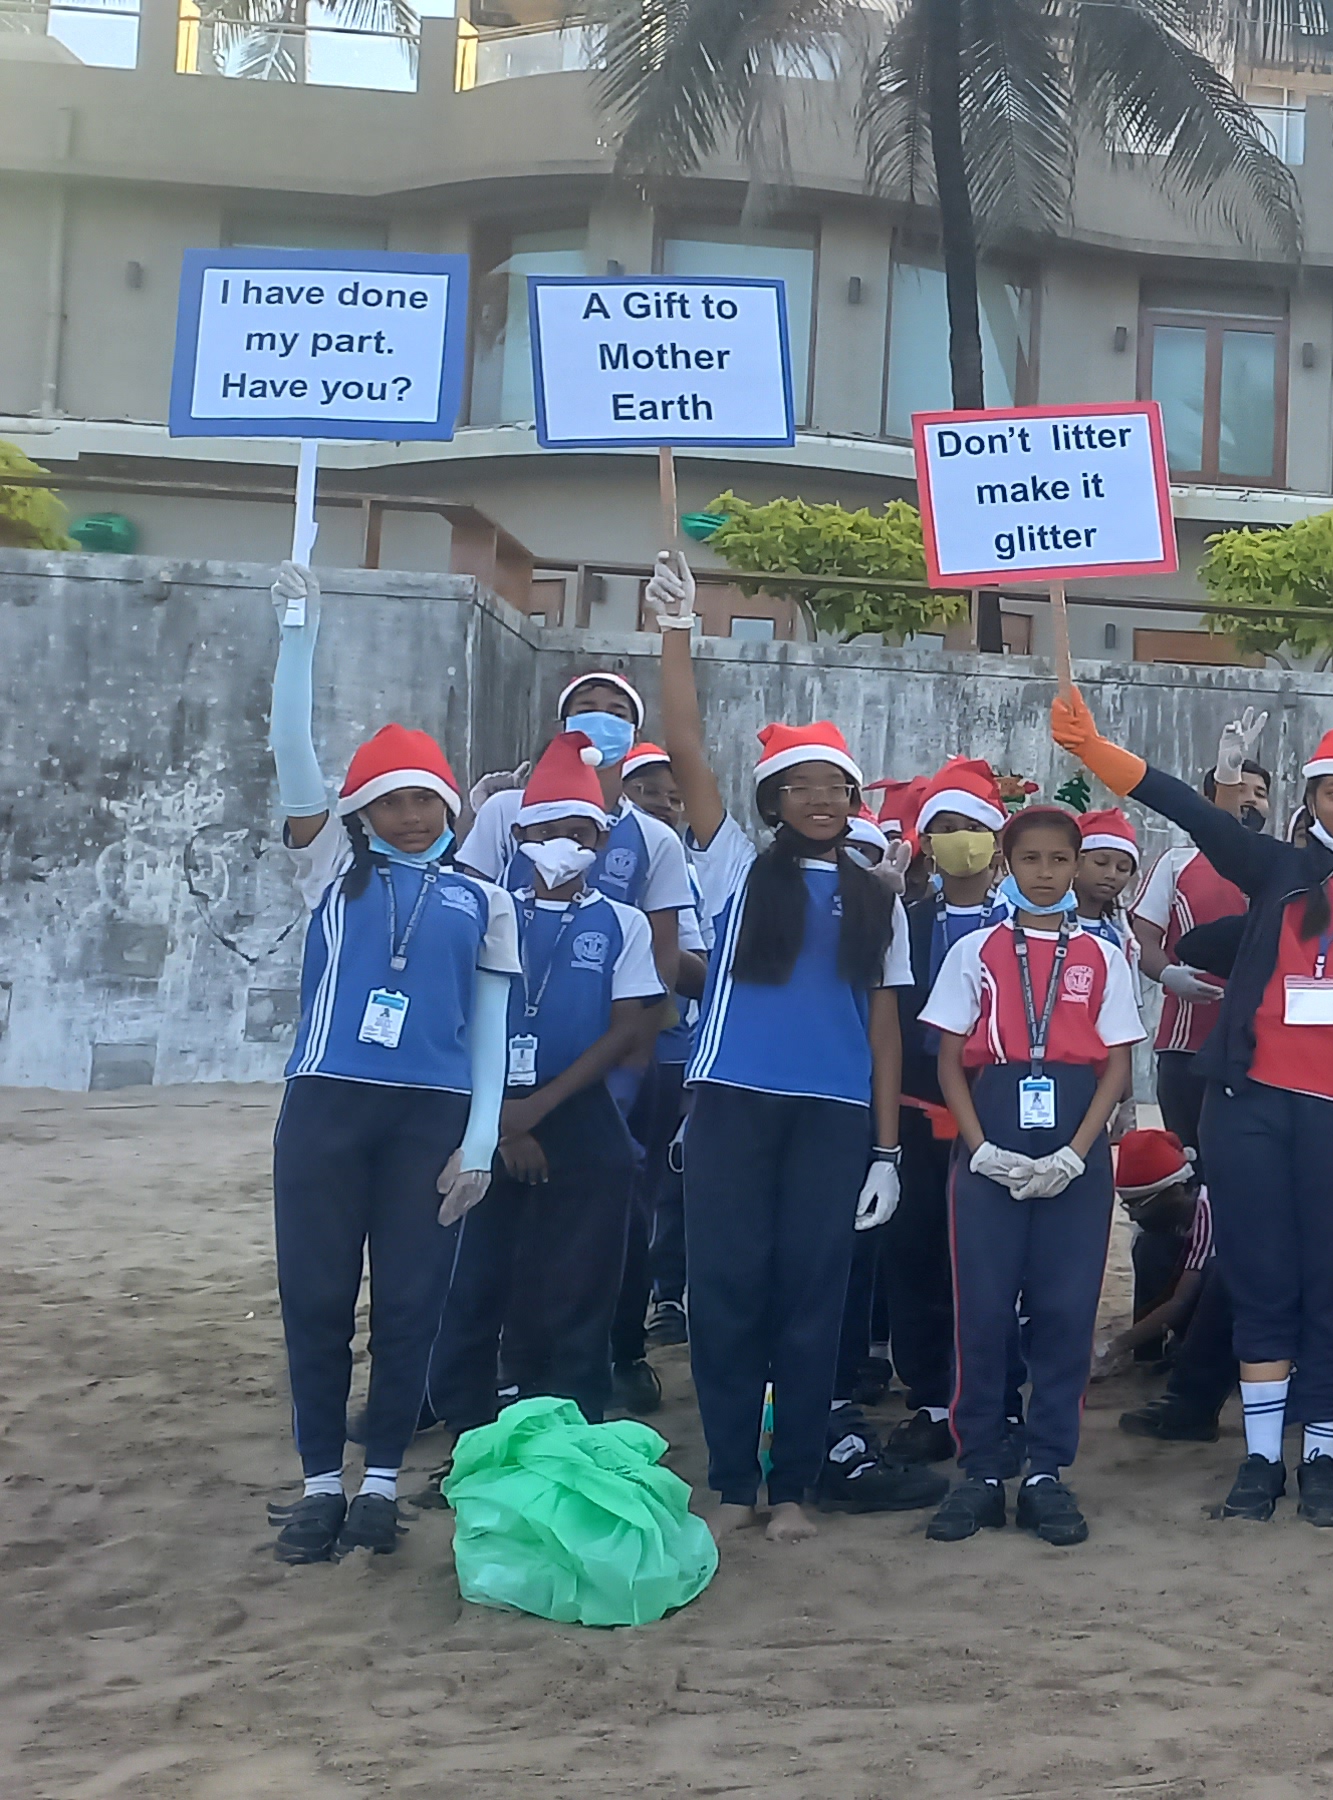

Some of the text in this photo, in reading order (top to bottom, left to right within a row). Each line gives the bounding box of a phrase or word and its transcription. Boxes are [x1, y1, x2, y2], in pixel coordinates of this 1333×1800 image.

[221, 279, 429, 310] I have done
[582, 291, 738, 320] A Gift to
[245, 330, 394, 358] my part.
[599, 342, 731, 370] Mother
[222, 372, 412, 406] Have you?
[612, 393, 713, 421] Earth
[1051, 424, 1132, 451] litter
[976, 472, 1105, 505] make it
[994, 524, 1097, 560] glitter
